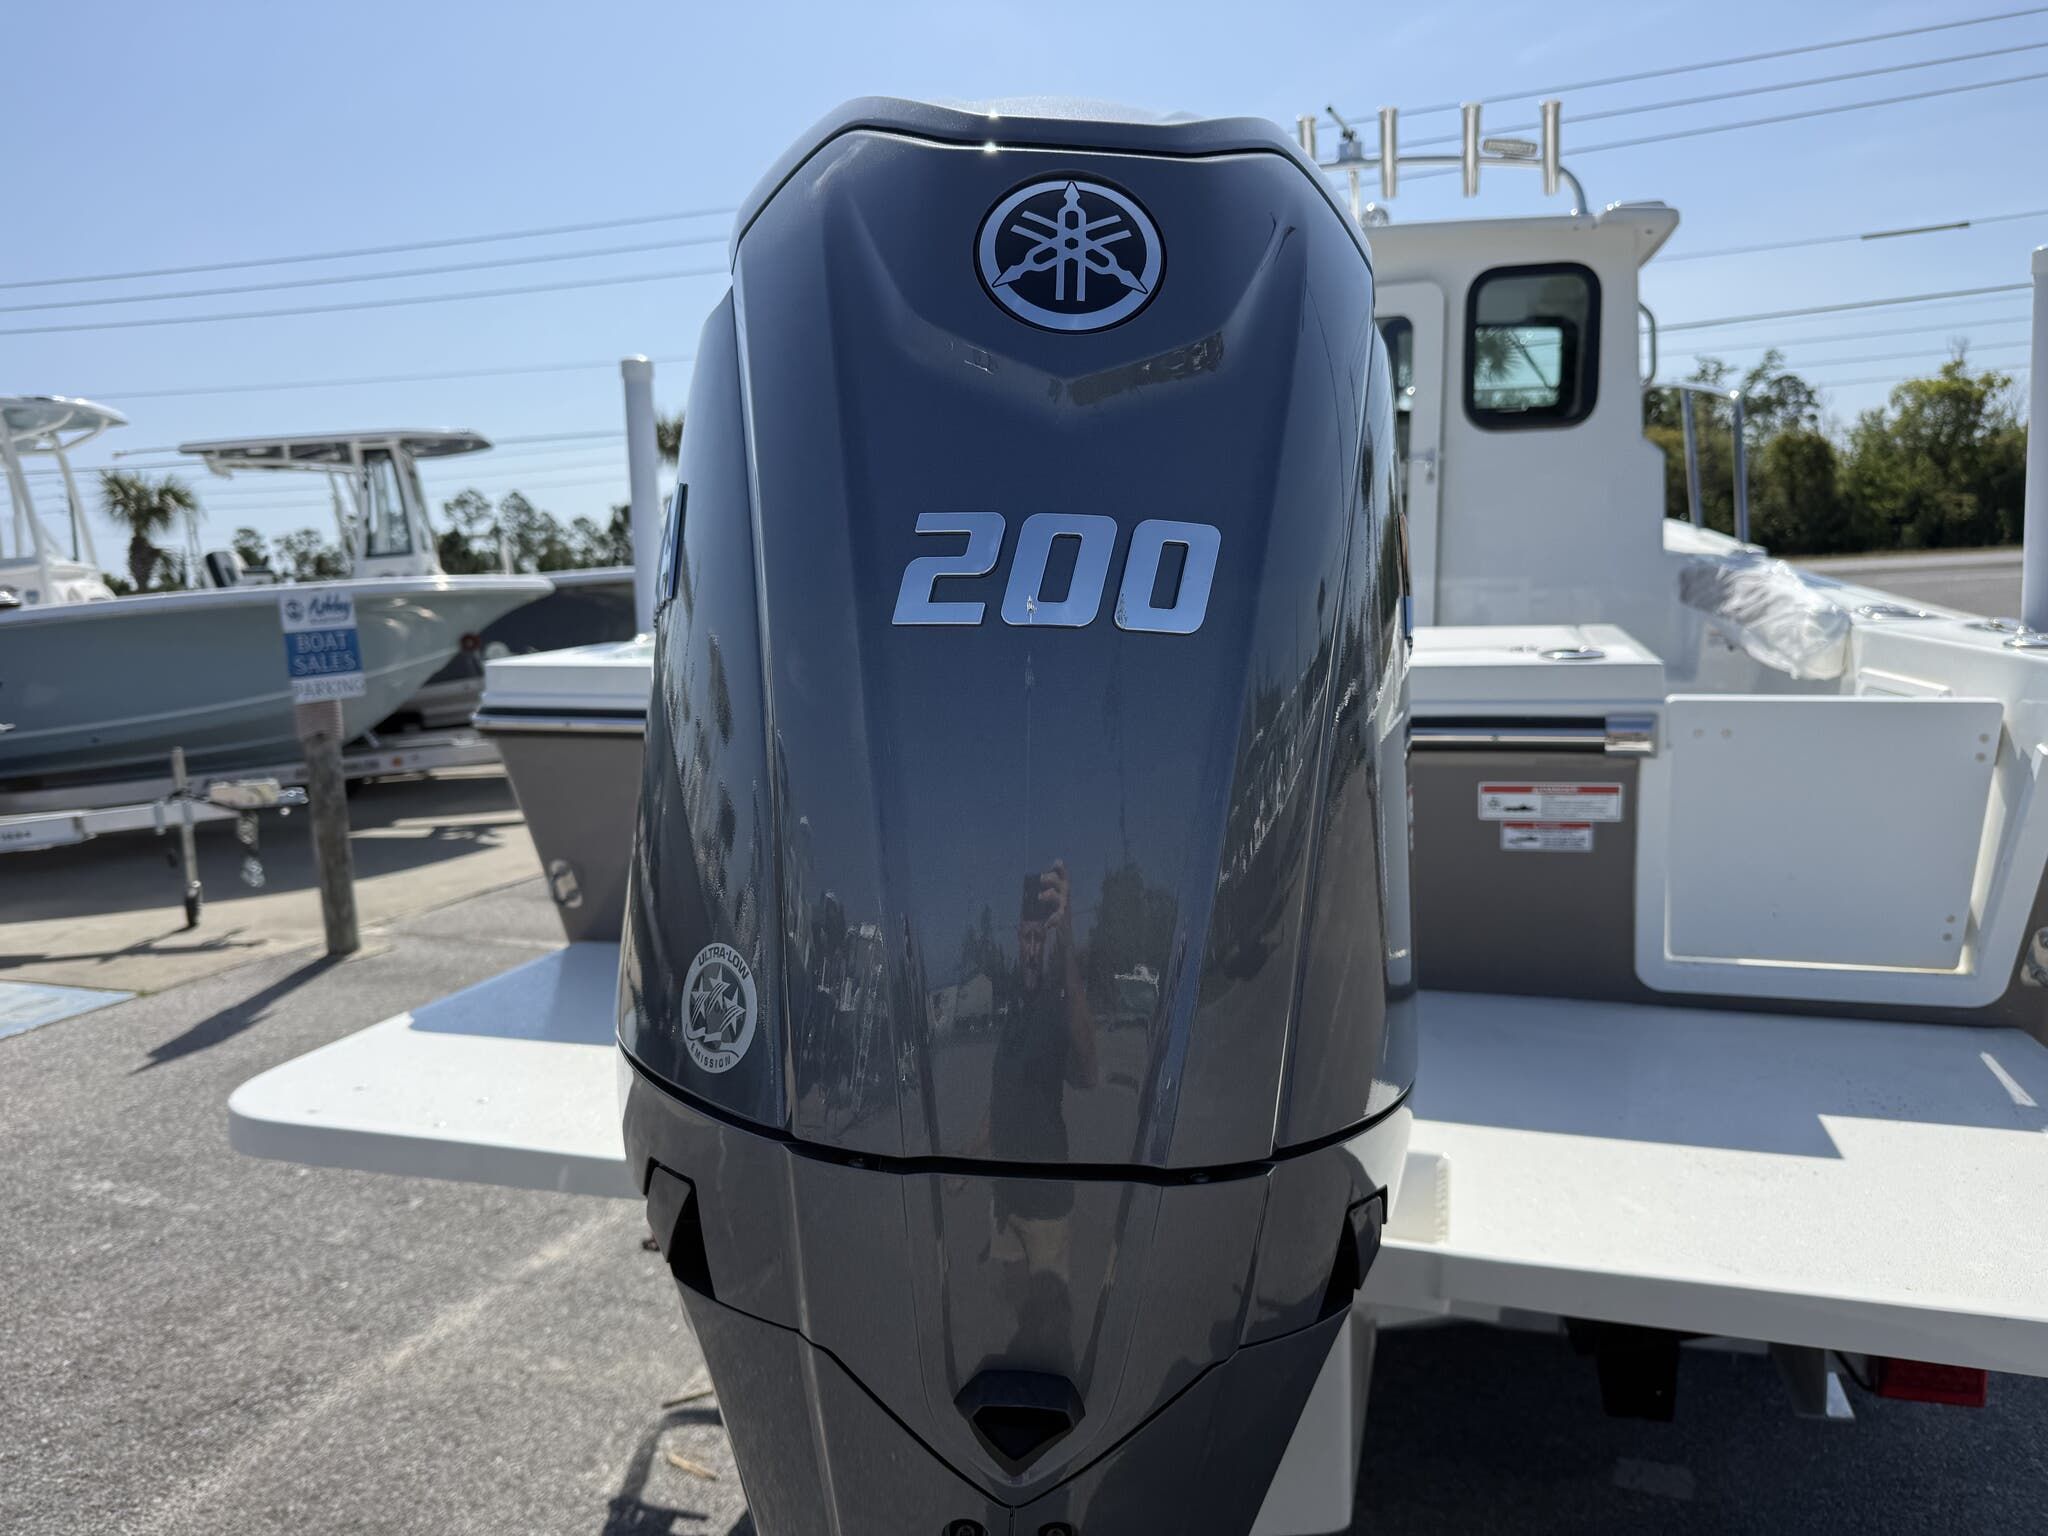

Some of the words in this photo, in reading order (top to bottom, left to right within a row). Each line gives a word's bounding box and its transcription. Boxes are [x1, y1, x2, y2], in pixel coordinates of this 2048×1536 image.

[892, 511, 1222, 634] 200
[296, 632, 347, 653] BOAT
[294, 652, 356, 675] SALES
[690, 1042, 731, 1069] EMISSION
